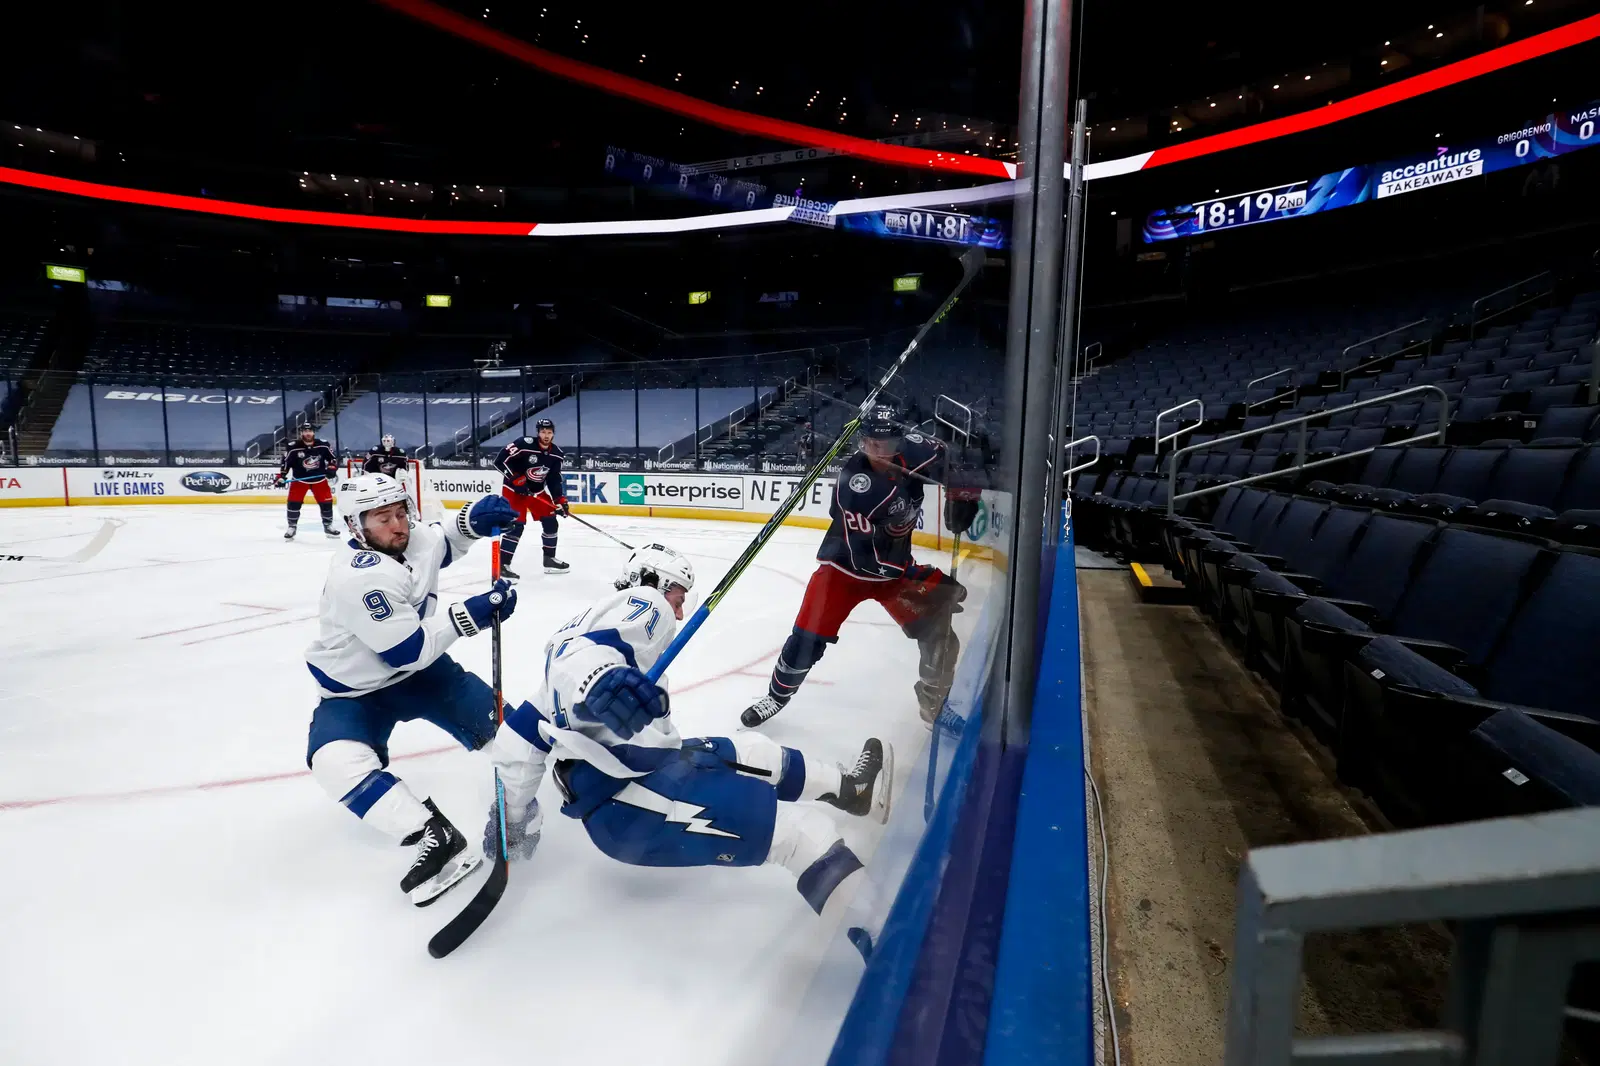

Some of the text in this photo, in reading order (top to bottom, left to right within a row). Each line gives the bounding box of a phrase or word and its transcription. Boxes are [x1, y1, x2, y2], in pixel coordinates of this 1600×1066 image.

[1497, 122, 1551, 144] GRIGORENKO
[1579, 121, 1595, 140] 0
[1515, 139, 1530, 158] 0
[1381, 148, 1481, 183] accenture
[1387, 165, 1473, 194] TAKEAWAYS
[1195, 192, 1304, 230] 18:19 2ND
[115, 456, 160, 464] Nationwide
[185, 457, 225, 465] Nationwide
[594, 460, 631, 469] Nationwide
[712, 462, 749, 471] Nationwide
[771, 462, 806, 472] Nationwide
[94, 482, 164, 496] LIVE GAMES
[430, 479, 492, 493] ationwide
[625, 481, 741, 501] enterprise
[844, 512, 872, 533] 20
[362, 589, 394, 622] 9
[621, 595, 661, 640] 71
